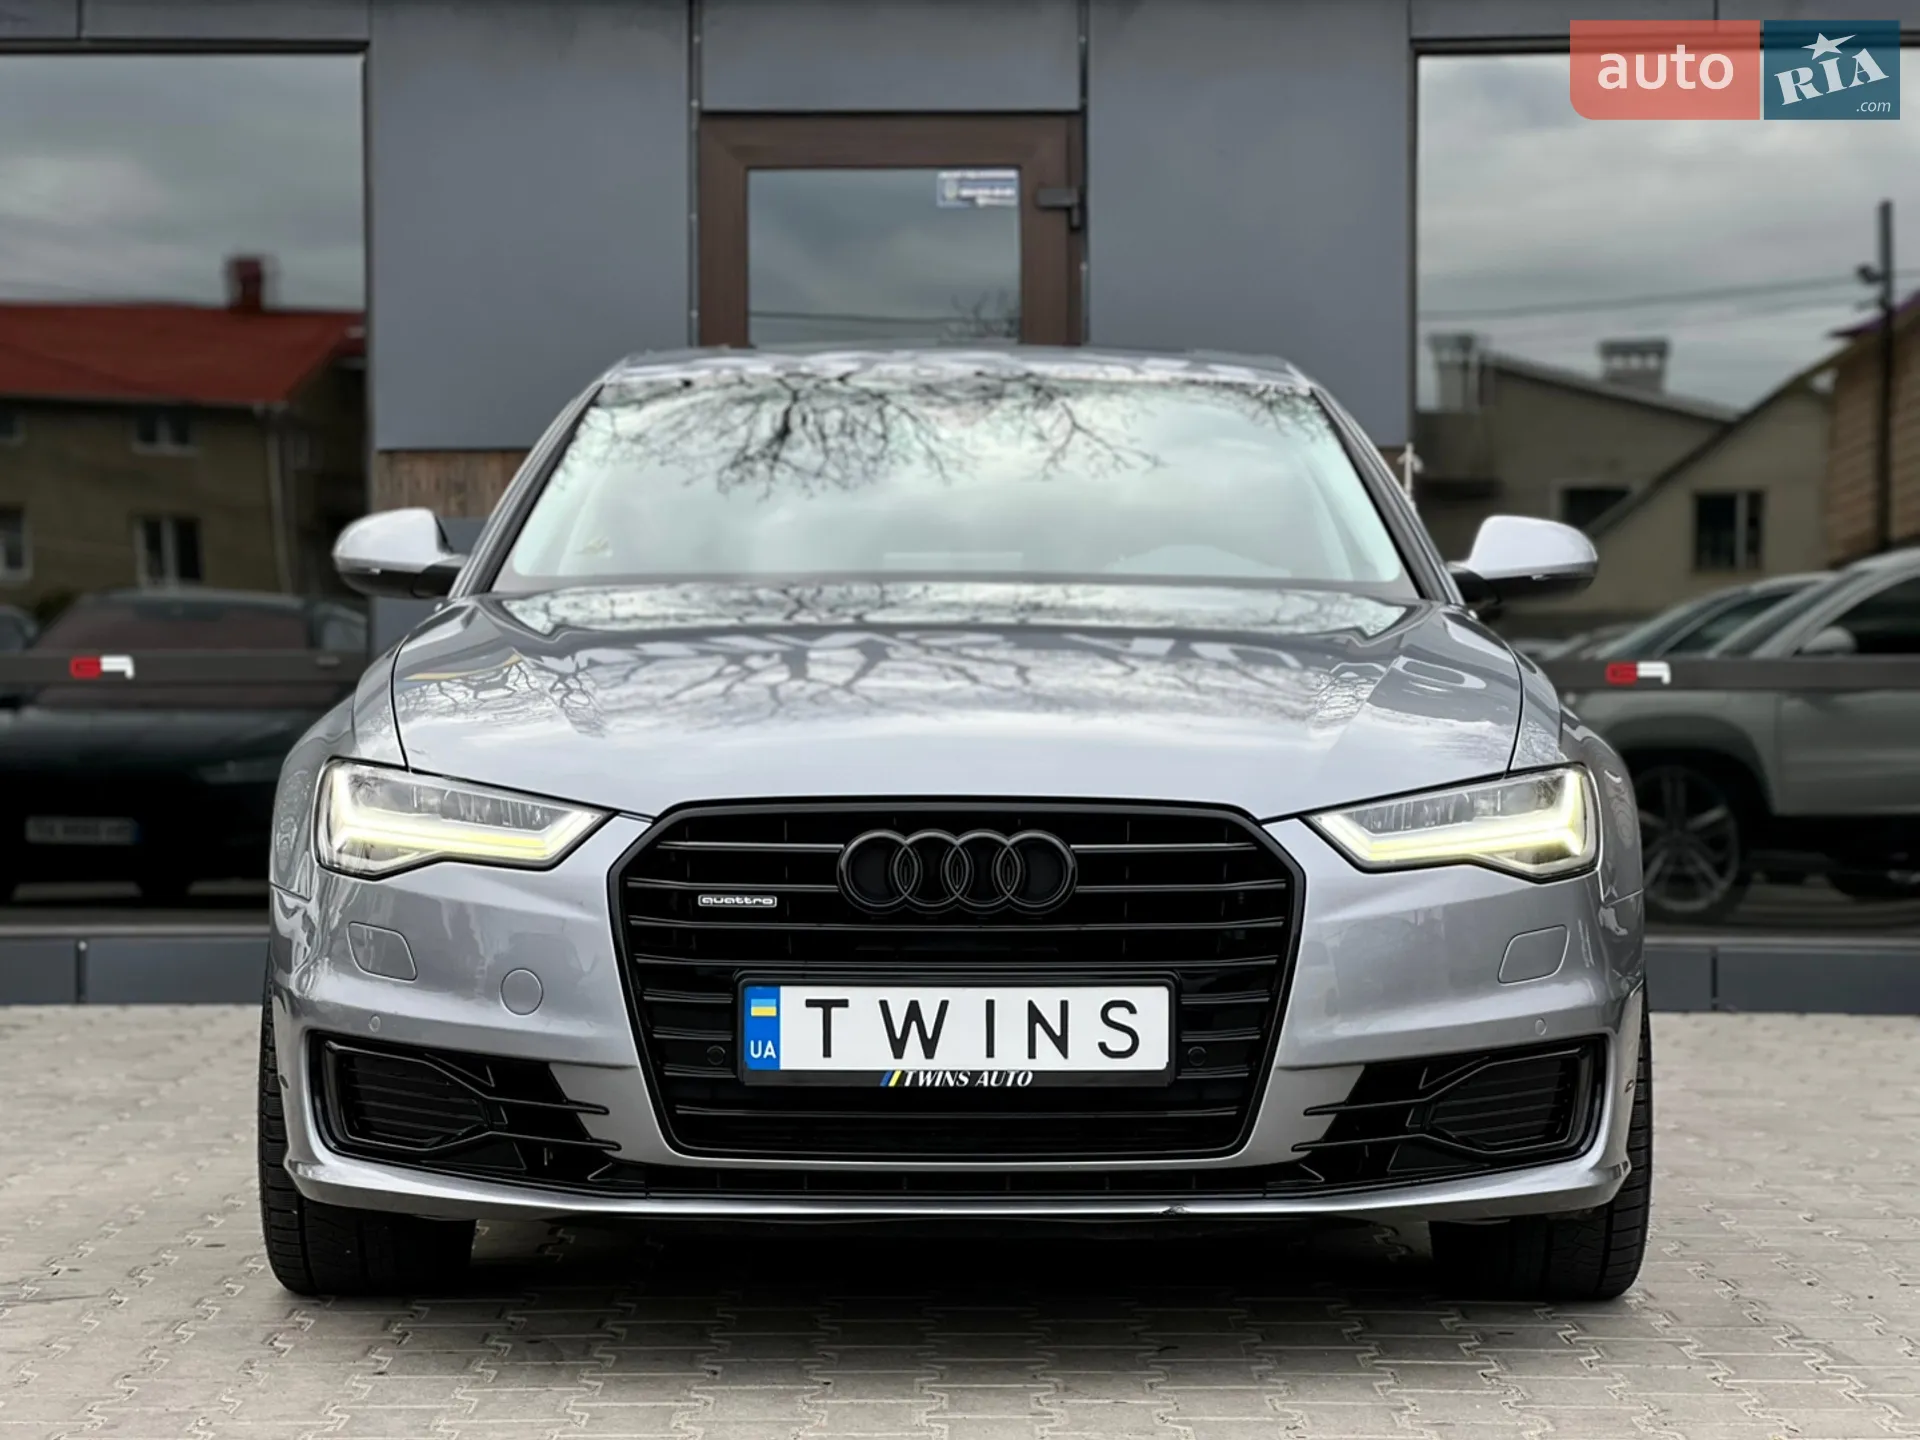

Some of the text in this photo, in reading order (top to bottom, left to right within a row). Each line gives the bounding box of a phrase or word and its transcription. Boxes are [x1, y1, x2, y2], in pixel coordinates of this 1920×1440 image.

[701, 895, 774, 905] quattro
[805, 998, 1140, 1060] TWINS
[750, 1040, 776, 1059] UA
[904, 1070, 1034, 1087] TWINS AUTO
